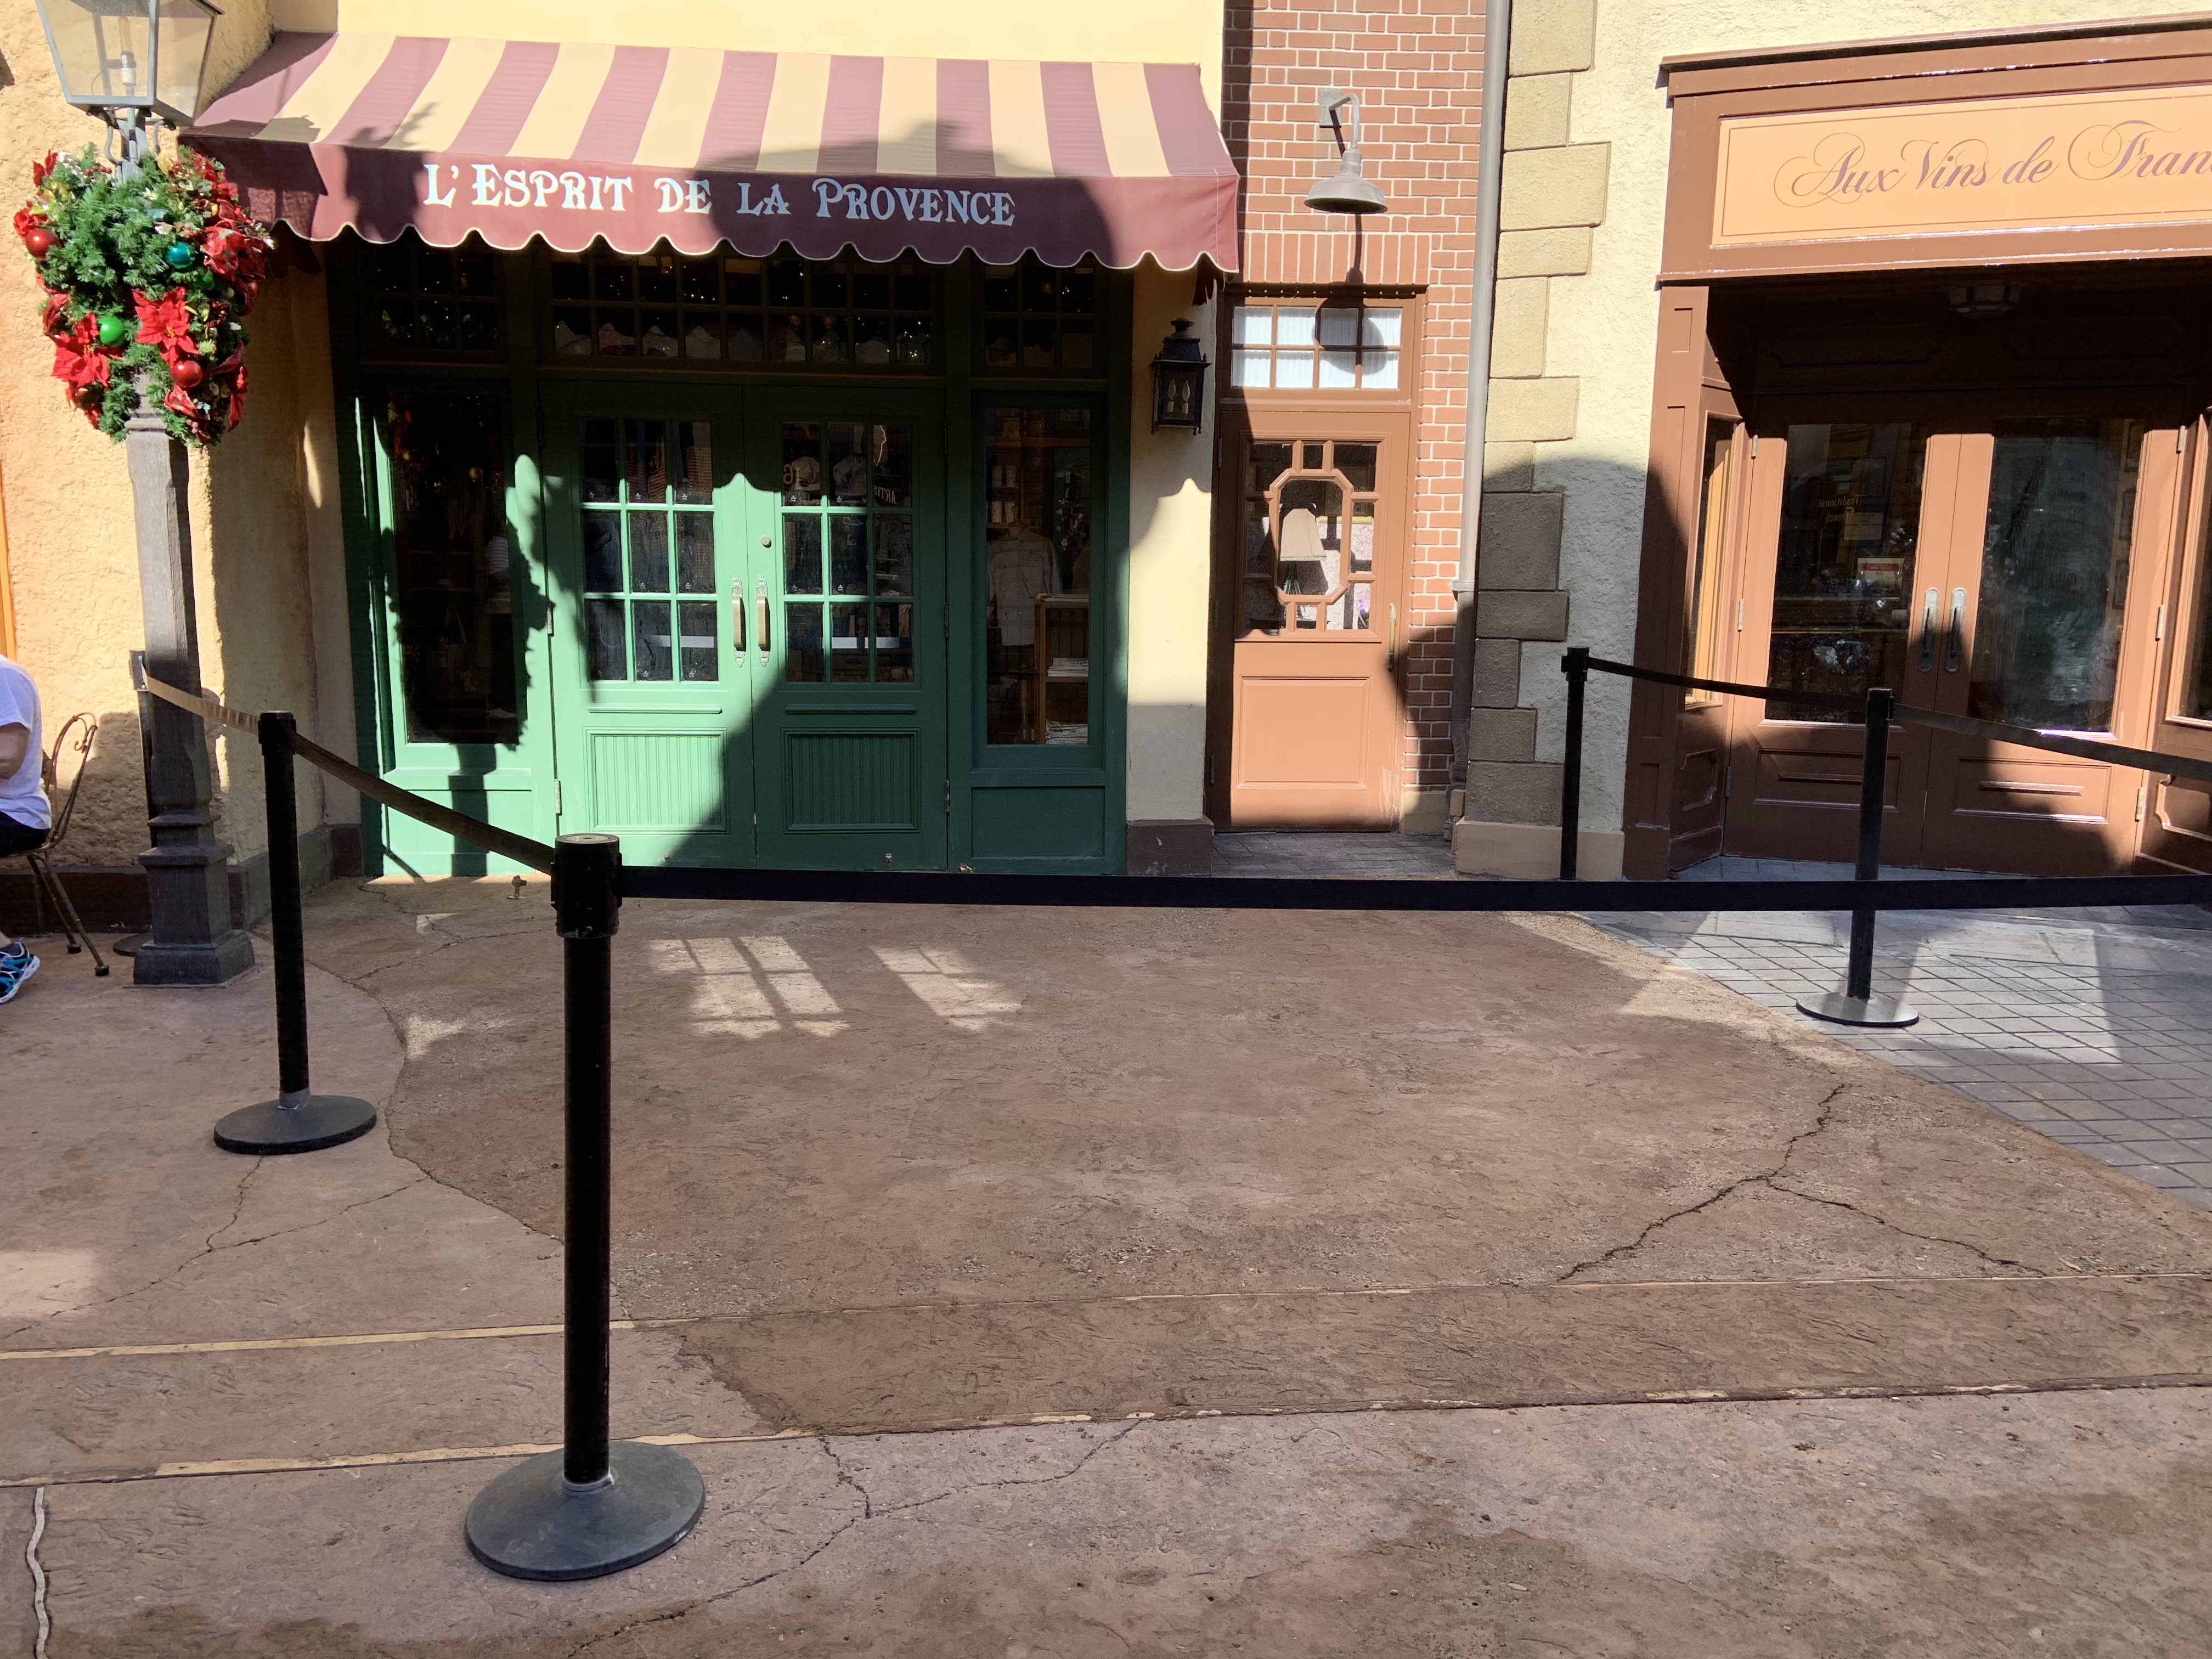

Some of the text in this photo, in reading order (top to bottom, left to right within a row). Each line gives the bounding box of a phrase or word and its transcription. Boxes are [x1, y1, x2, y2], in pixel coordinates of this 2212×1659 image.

[1774, 120, 2212, 208] Aux Vins de Fran
[653, 177, 712, 215] DE
[736, 182, 791, 216] LA
[812, 177, 1015, 226] PROVENCE
